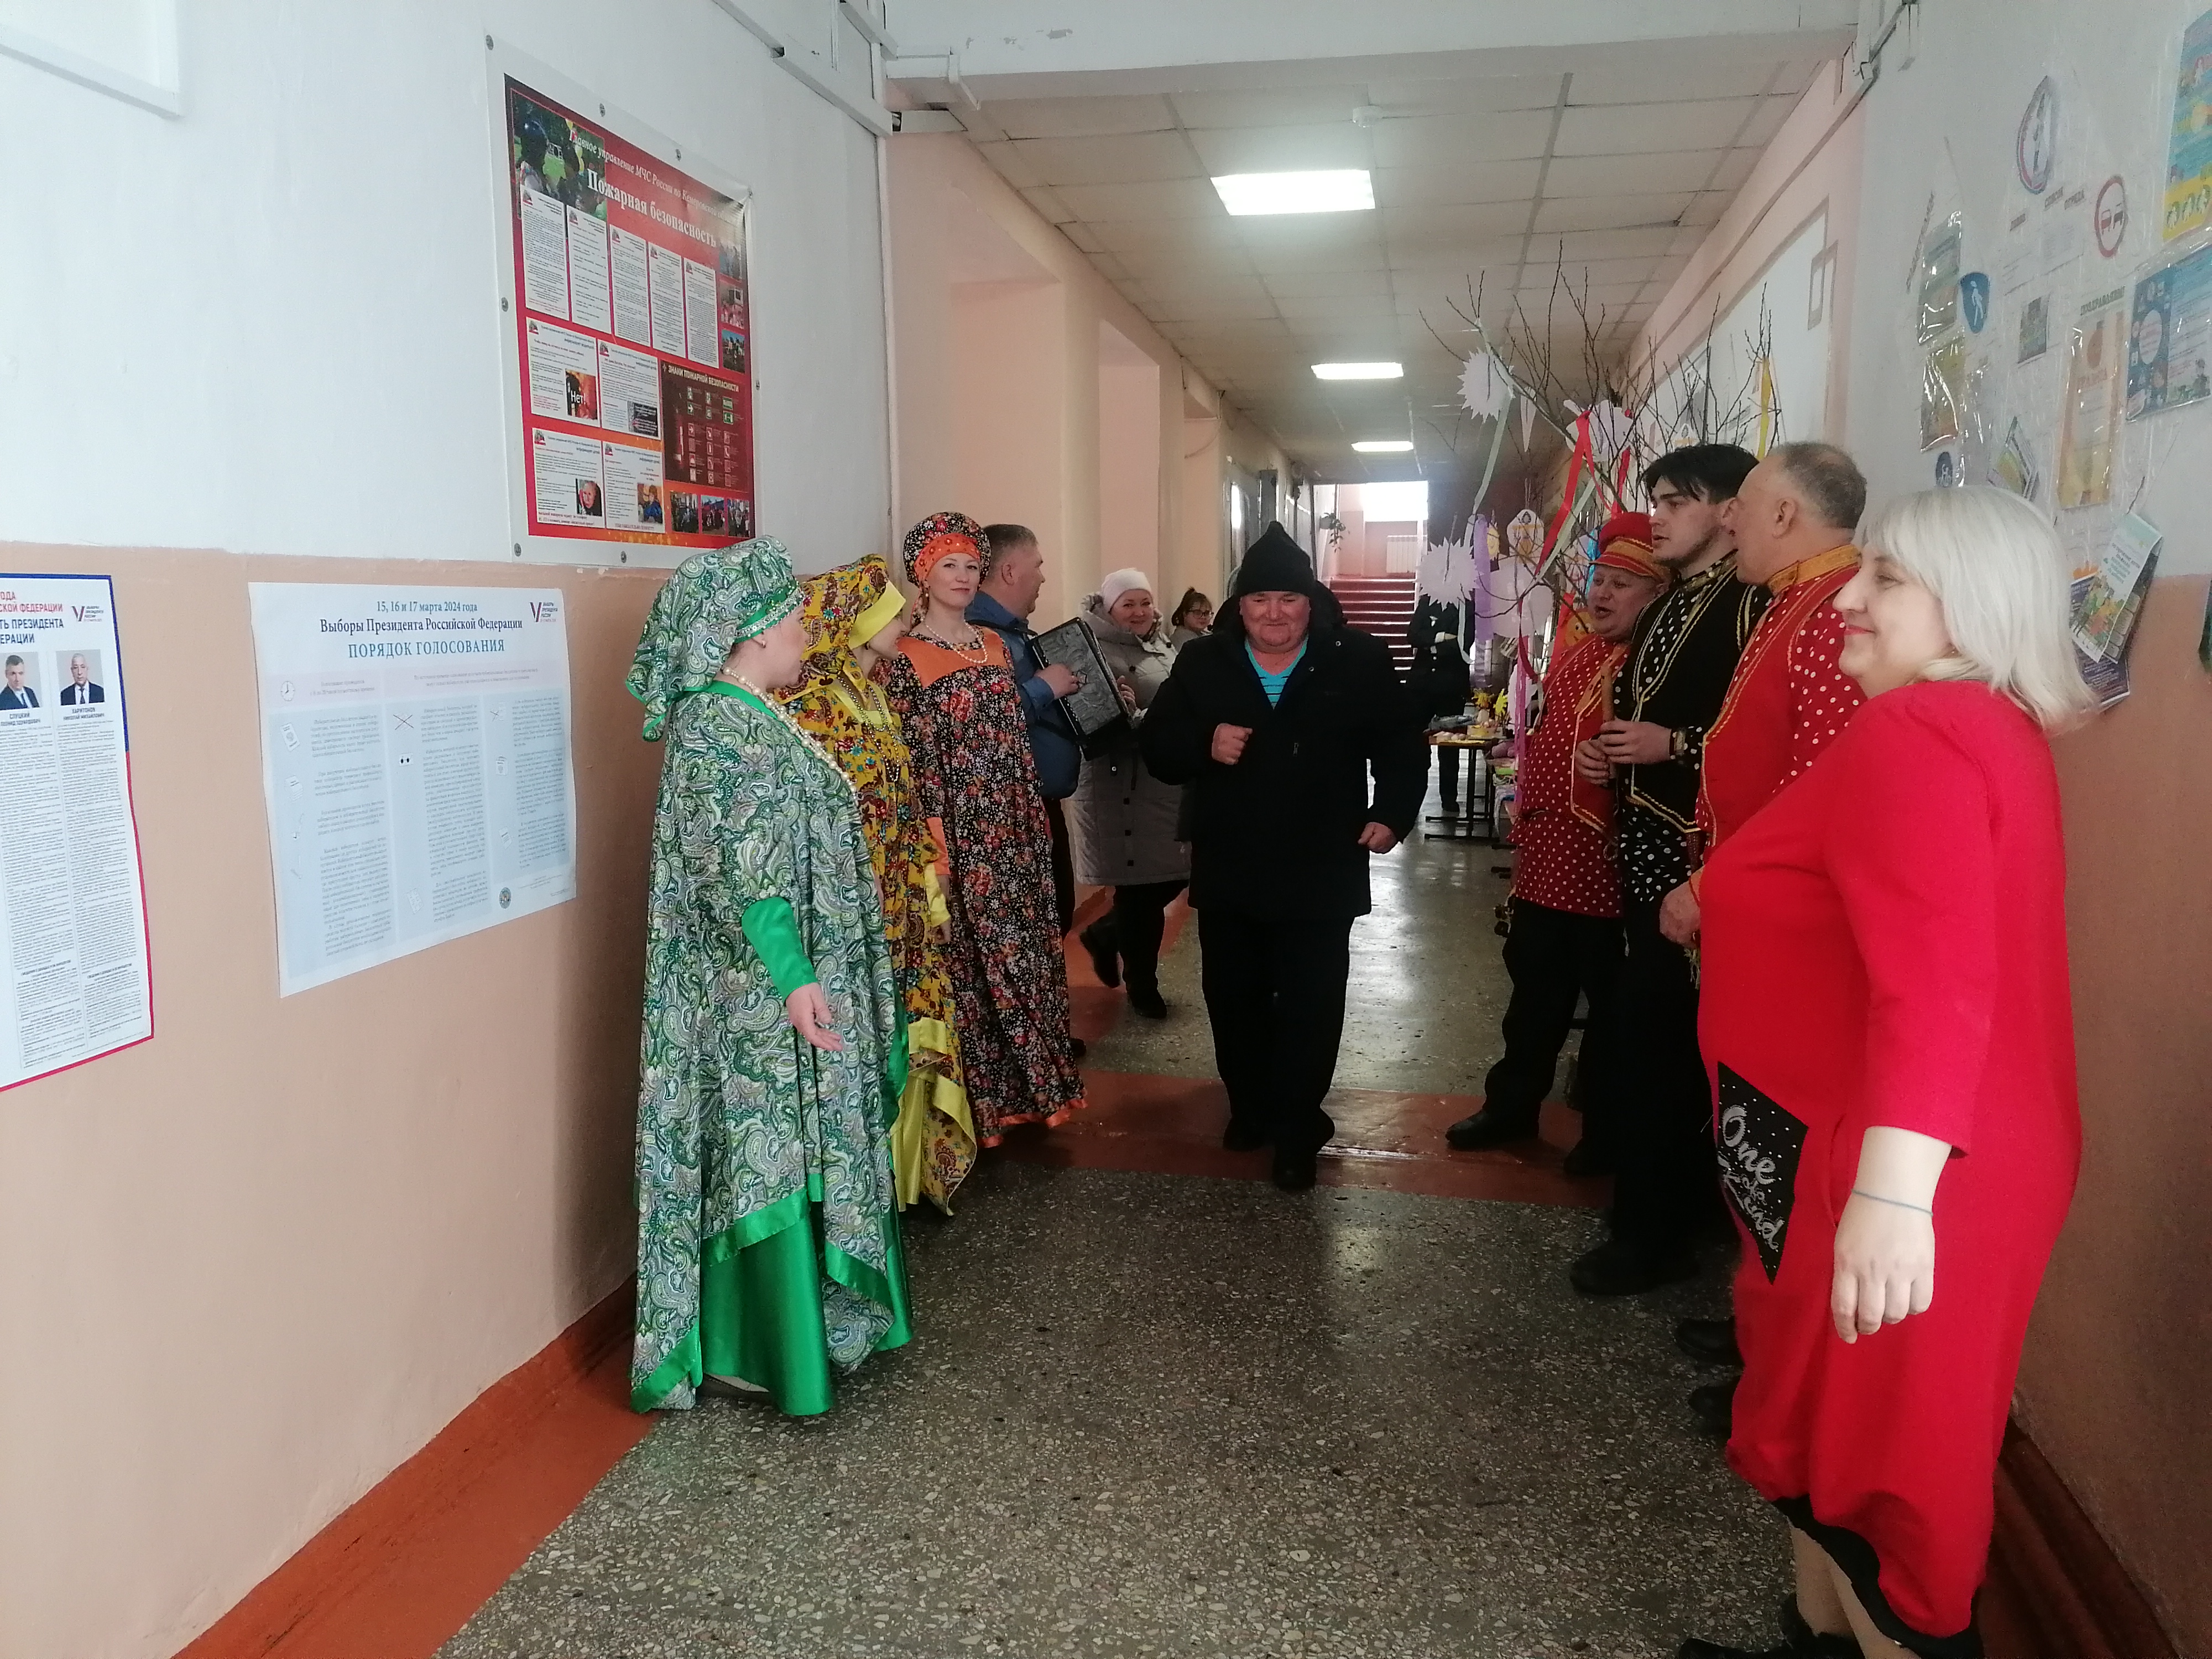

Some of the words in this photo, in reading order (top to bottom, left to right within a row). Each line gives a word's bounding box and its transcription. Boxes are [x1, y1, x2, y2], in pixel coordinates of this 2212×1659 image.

[569, 129, 597, 154] Главное
[598, 147, 634, 174] управление
[636, 165, 651, 183] МЧС
[653, 174, 672, 194] России
[674, 187, 681, 198] по
[587, 169, 648, 216] Пожарная
[650, 201, 717, 248] безопасность
[571, 390, 586, 405] Нет!
[19, 603, 63, 613] ФЕДЕРАЦИИ
[377, 601, 388, 613] 15,
[391, 601, 399, 612] 16
[409, 601, 418, 612] 17
[419, 603, 442, 614] марта
[444, 602, 461, 612] 2024
[462, 604, 477, 612] года
[12, 619, 64, 630] ПРЕЗИДЕНТА
[320, 618, 363, 635] Выборы
[366, 619, 424, 635] Президента
[425, 618, 476, 630] Российской
[478, 618, 523, 632] Федерации
[348, 642, 412, 659] ПОРЯДОК
[416, 639, 504, 655] ГОЛОСОВАНИЯ
[1722, 1105, 1777, 1185] One
